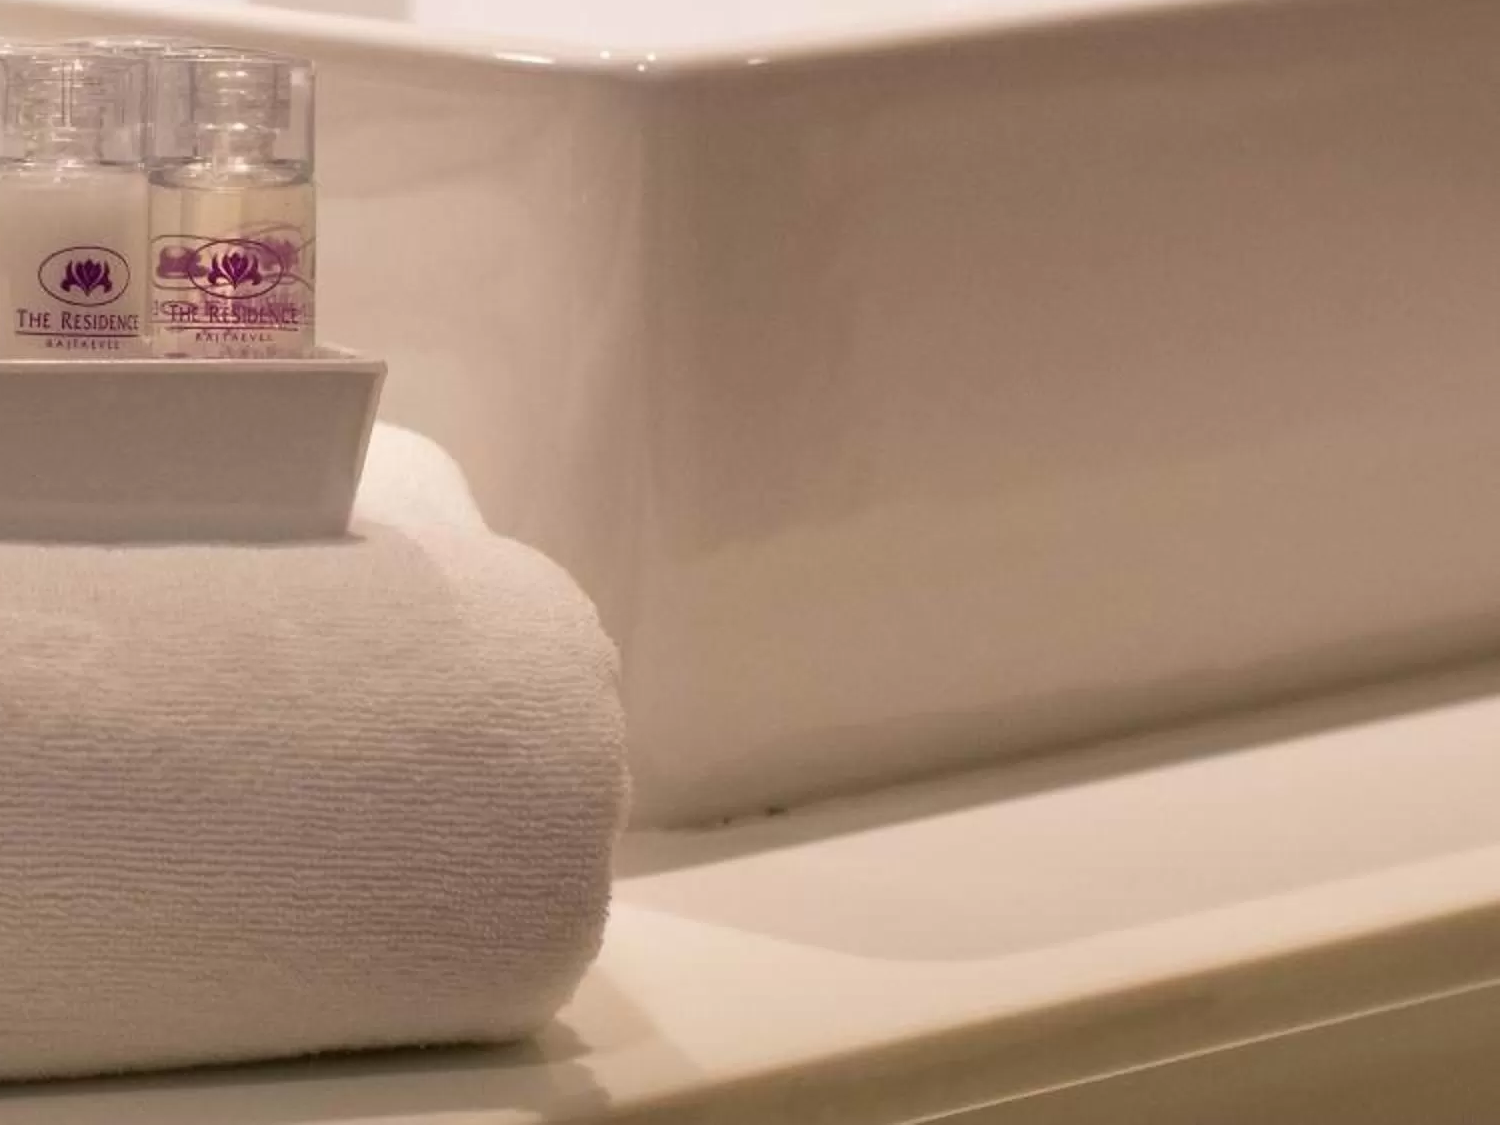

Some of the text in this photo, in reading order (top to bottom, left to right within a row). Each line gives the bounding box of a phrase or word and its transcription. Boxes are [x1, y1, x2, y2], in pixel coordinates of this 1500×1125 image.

[16, 308, 140, 330] THE RESIDENCE
[170, 304, 198, 323] THE
